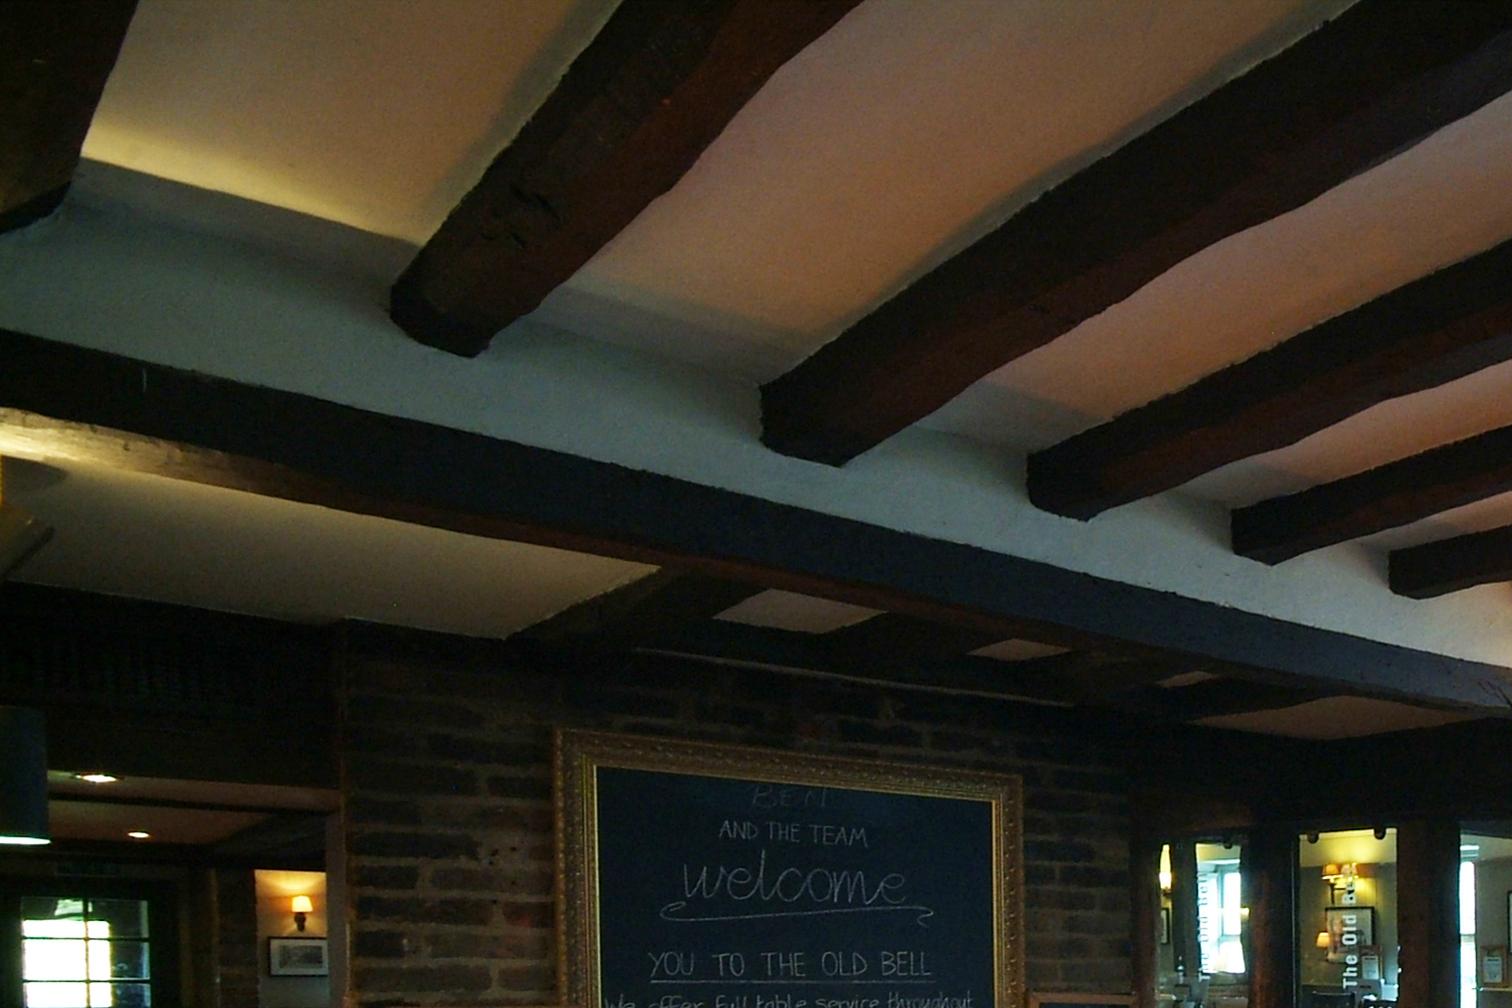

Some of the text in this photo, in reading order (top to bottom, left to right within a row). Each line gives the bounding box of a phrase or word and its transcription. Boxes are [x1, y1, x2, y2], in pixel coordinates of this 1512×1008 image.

[719, 820, 869, 848] AND THE TEAM
[683, 849, 905, 905] welcome
[1342, 914, 1358, 945] Old
[648, 950, 932, 977] YOU TO THE OLD BELL
[1342, 955, 1358, 989] The
